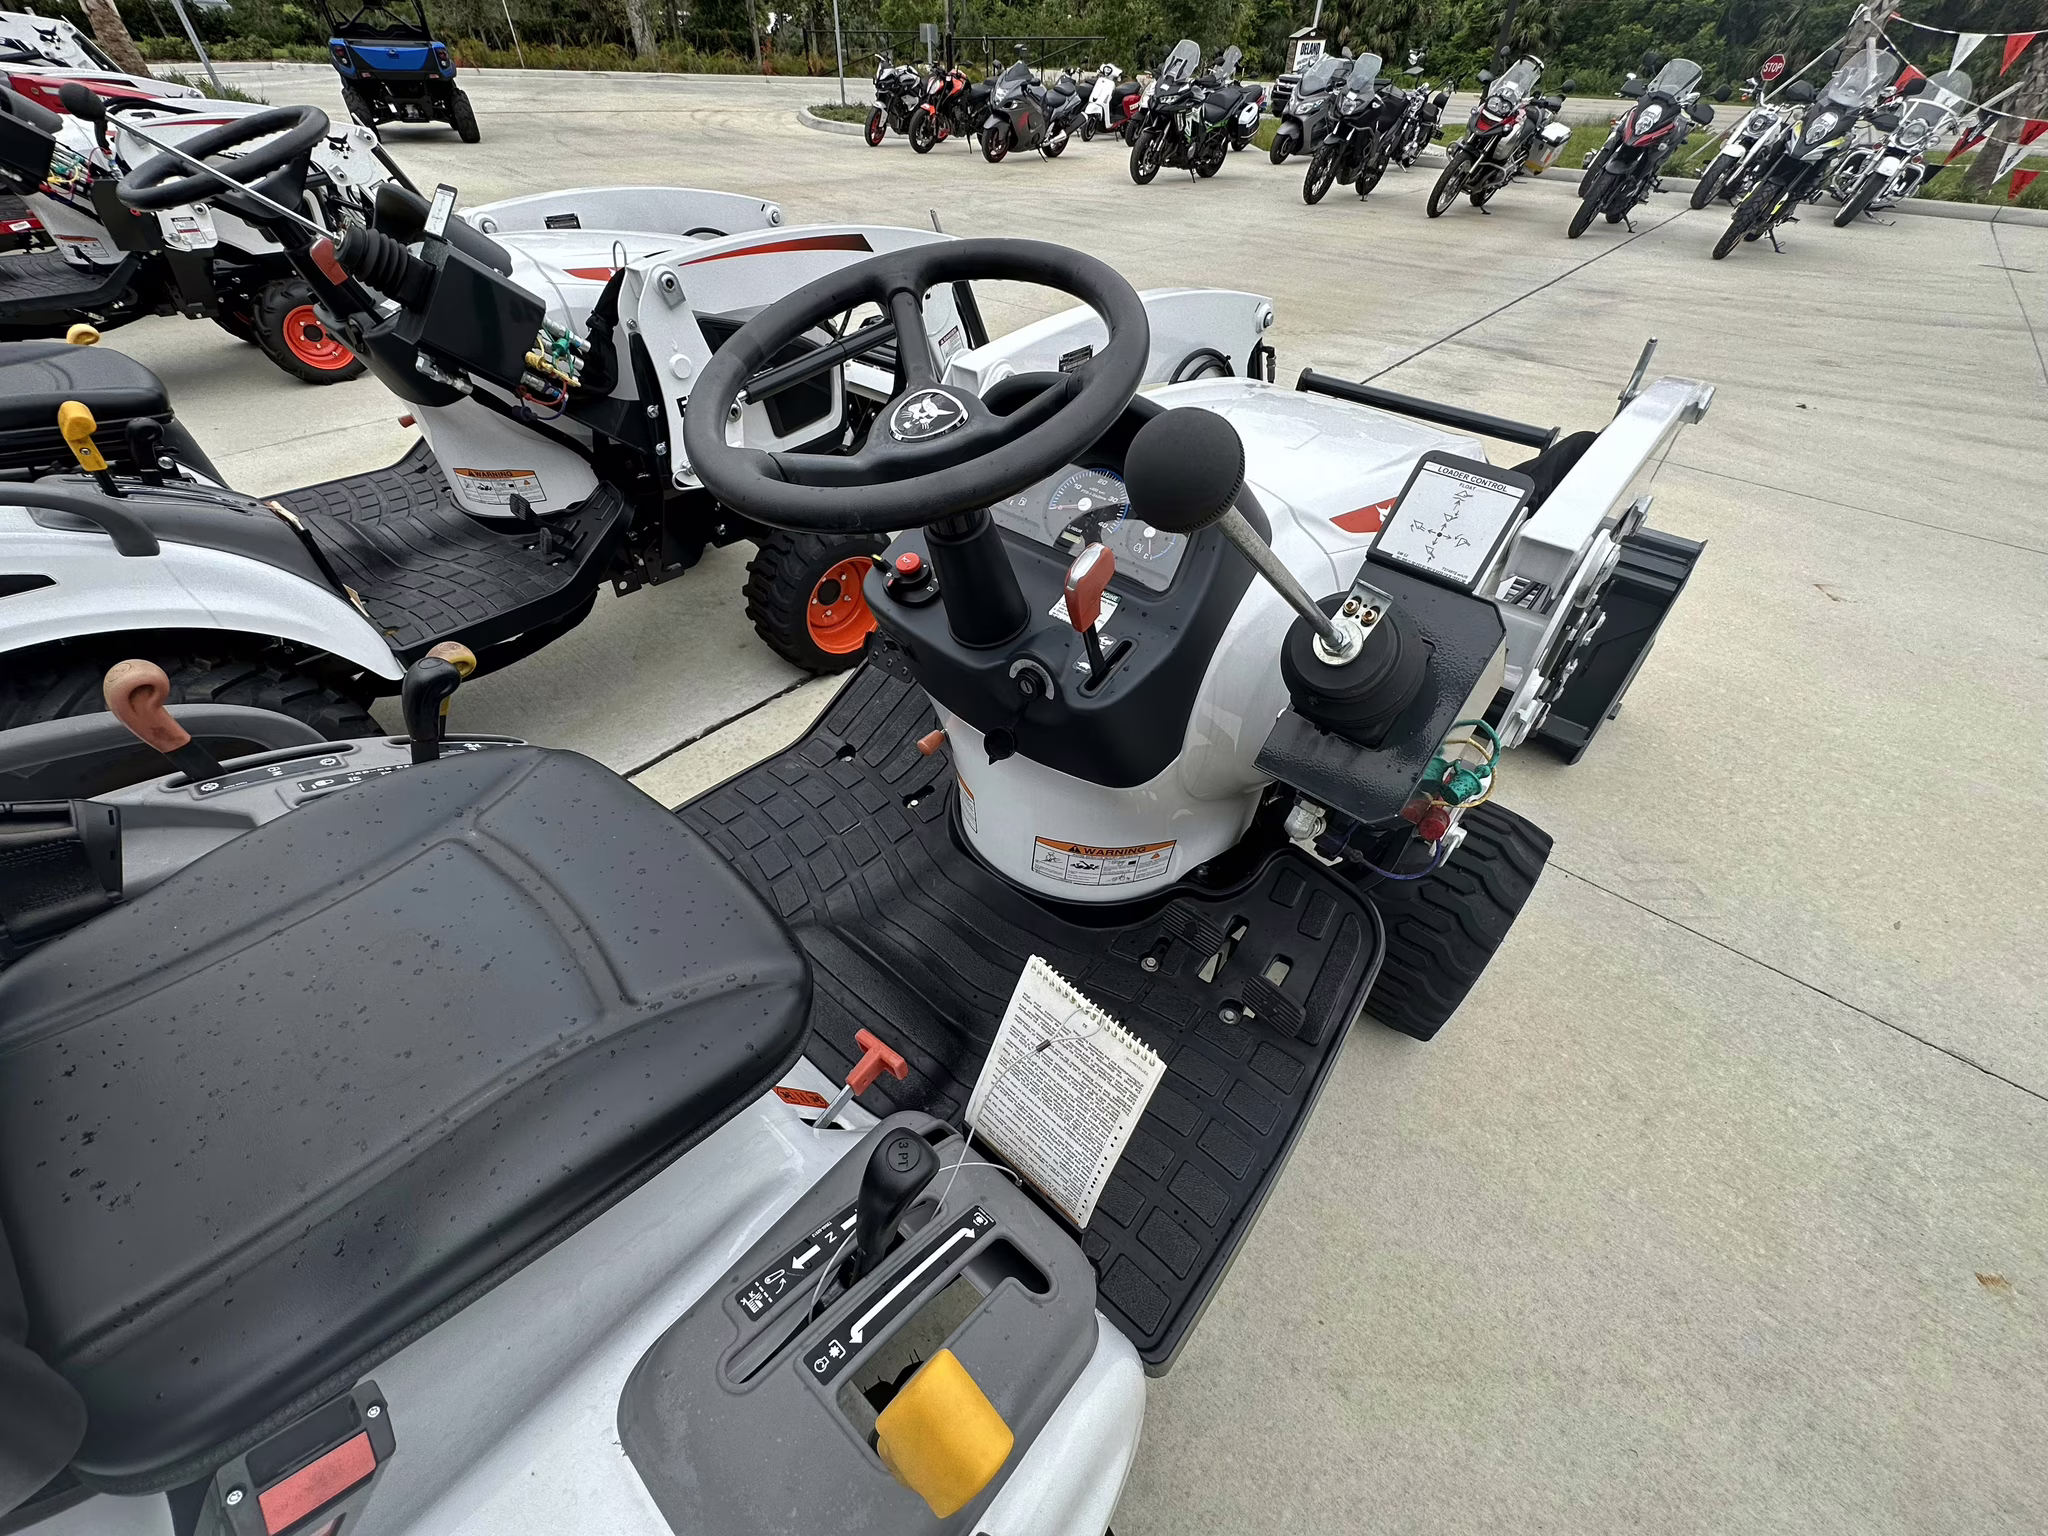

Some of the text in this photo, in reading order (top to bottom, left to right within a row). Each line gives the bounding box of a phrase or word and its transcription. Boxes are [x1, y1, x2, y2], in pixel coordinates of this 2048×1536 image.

[1763, 62, 1783, 73] STOP
[475, 470, 513, 479] WARNING
[1097, 478, 1108, 486] 20
[1438, 466, 1508, 493] LOADER CONTROL
[1459, 483, 1477, 491] FLOAT
[1108, 495, 1119, 503] 30
[1098, 521, 1108, 529] 40
[1083, 846, 1147, 856] WARNING
[898, 1152, 909, 1168] PT
